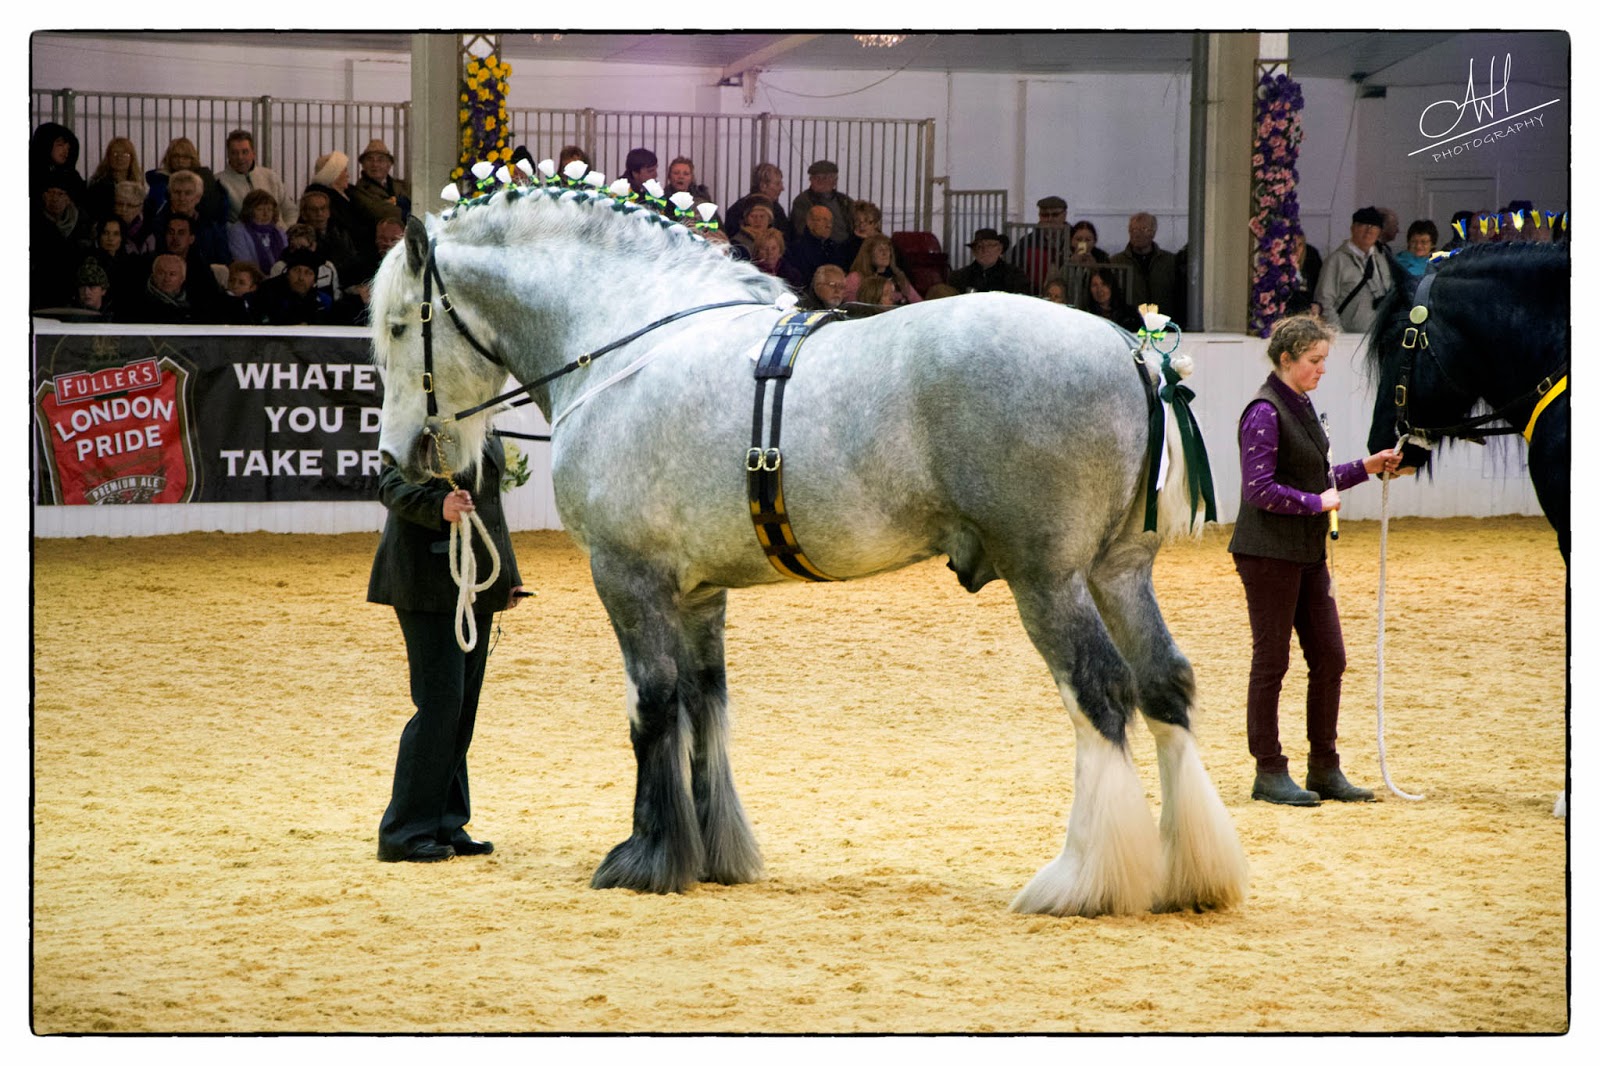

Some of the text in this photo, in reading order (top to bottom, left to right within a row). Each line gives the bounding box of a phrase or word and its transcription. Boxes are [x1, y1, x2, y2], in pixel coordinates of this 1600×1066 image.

[62, 365, 153, 398] FULLER'S
[54, 396, 174, 442] LONDON
[264, 406, 344, 433] YOU
[76, 425, 163, 462] PRIDE
[220, 449, 323, 477] TAKE
[92, 477, 159, 500] PREMIUM ALE
